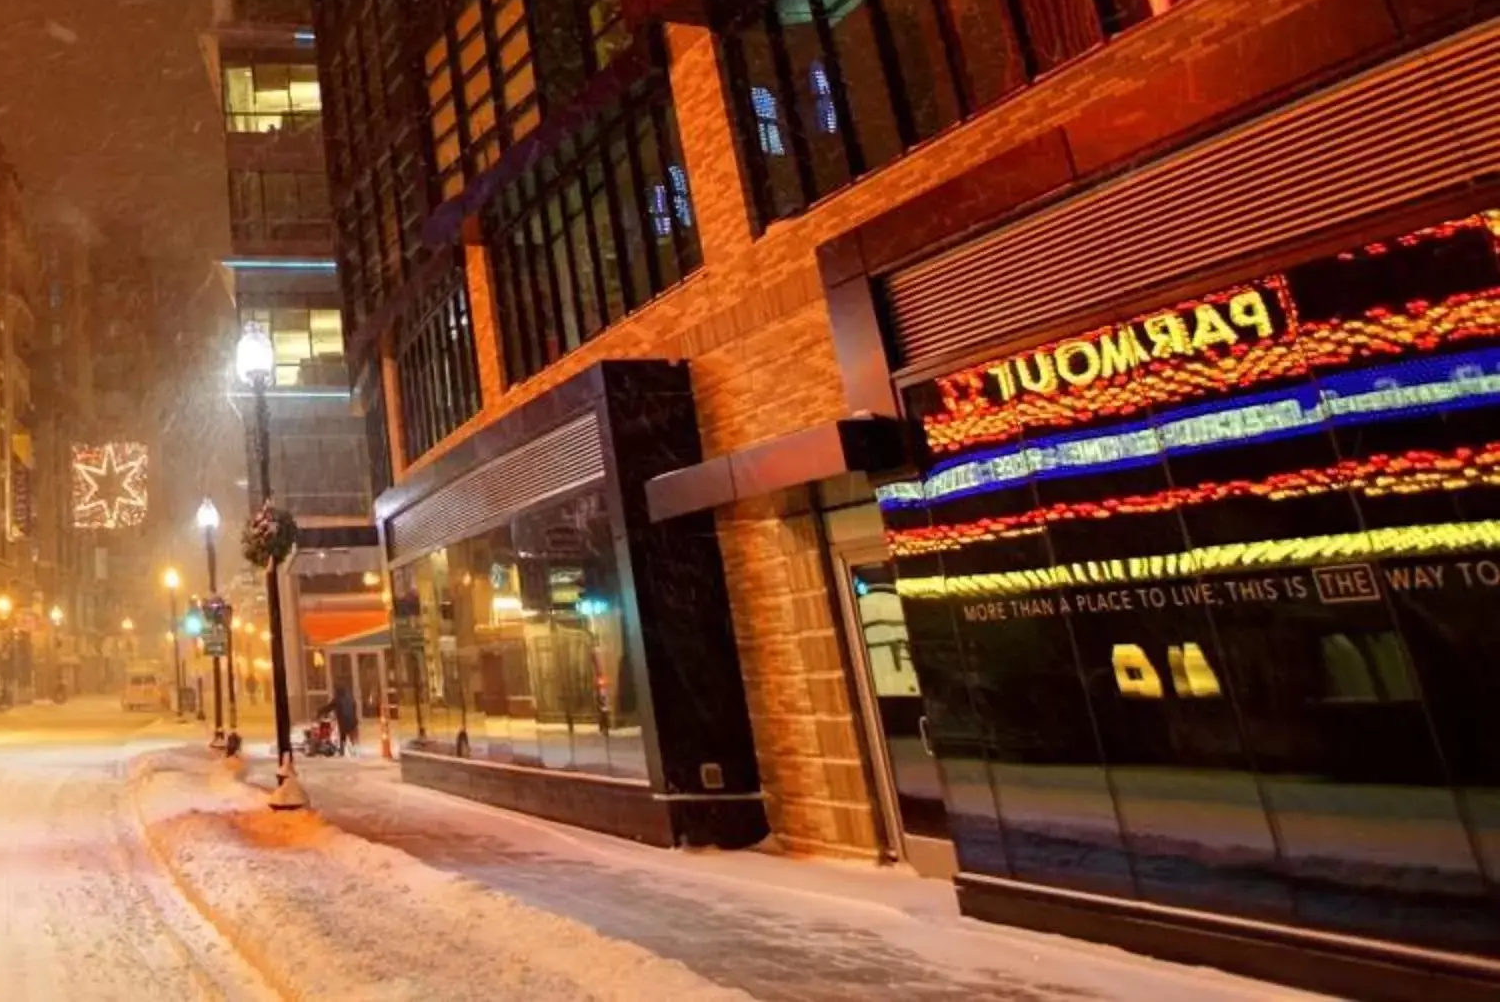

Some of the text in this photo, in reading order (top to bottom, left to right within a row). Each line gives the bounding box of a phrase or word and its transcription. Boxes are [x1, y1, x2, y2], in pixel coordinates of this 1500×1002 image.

[963, 601, 1007, 622] MORE
[1010, 598, 1054, 618] THAN
[1059, 597, 1072, 614] A
[1076, 589, 1133, 612] PLACE
[1136, 587, 1166, 608] TO
[1224, 577, 1279, 603] THIS
[1283, 575, 1308, 598] IS
[1320, 569, 1371, 596] THE
[1384, 565, 1444, 591] WAY
[1456, 560, 1500, 587] TO
